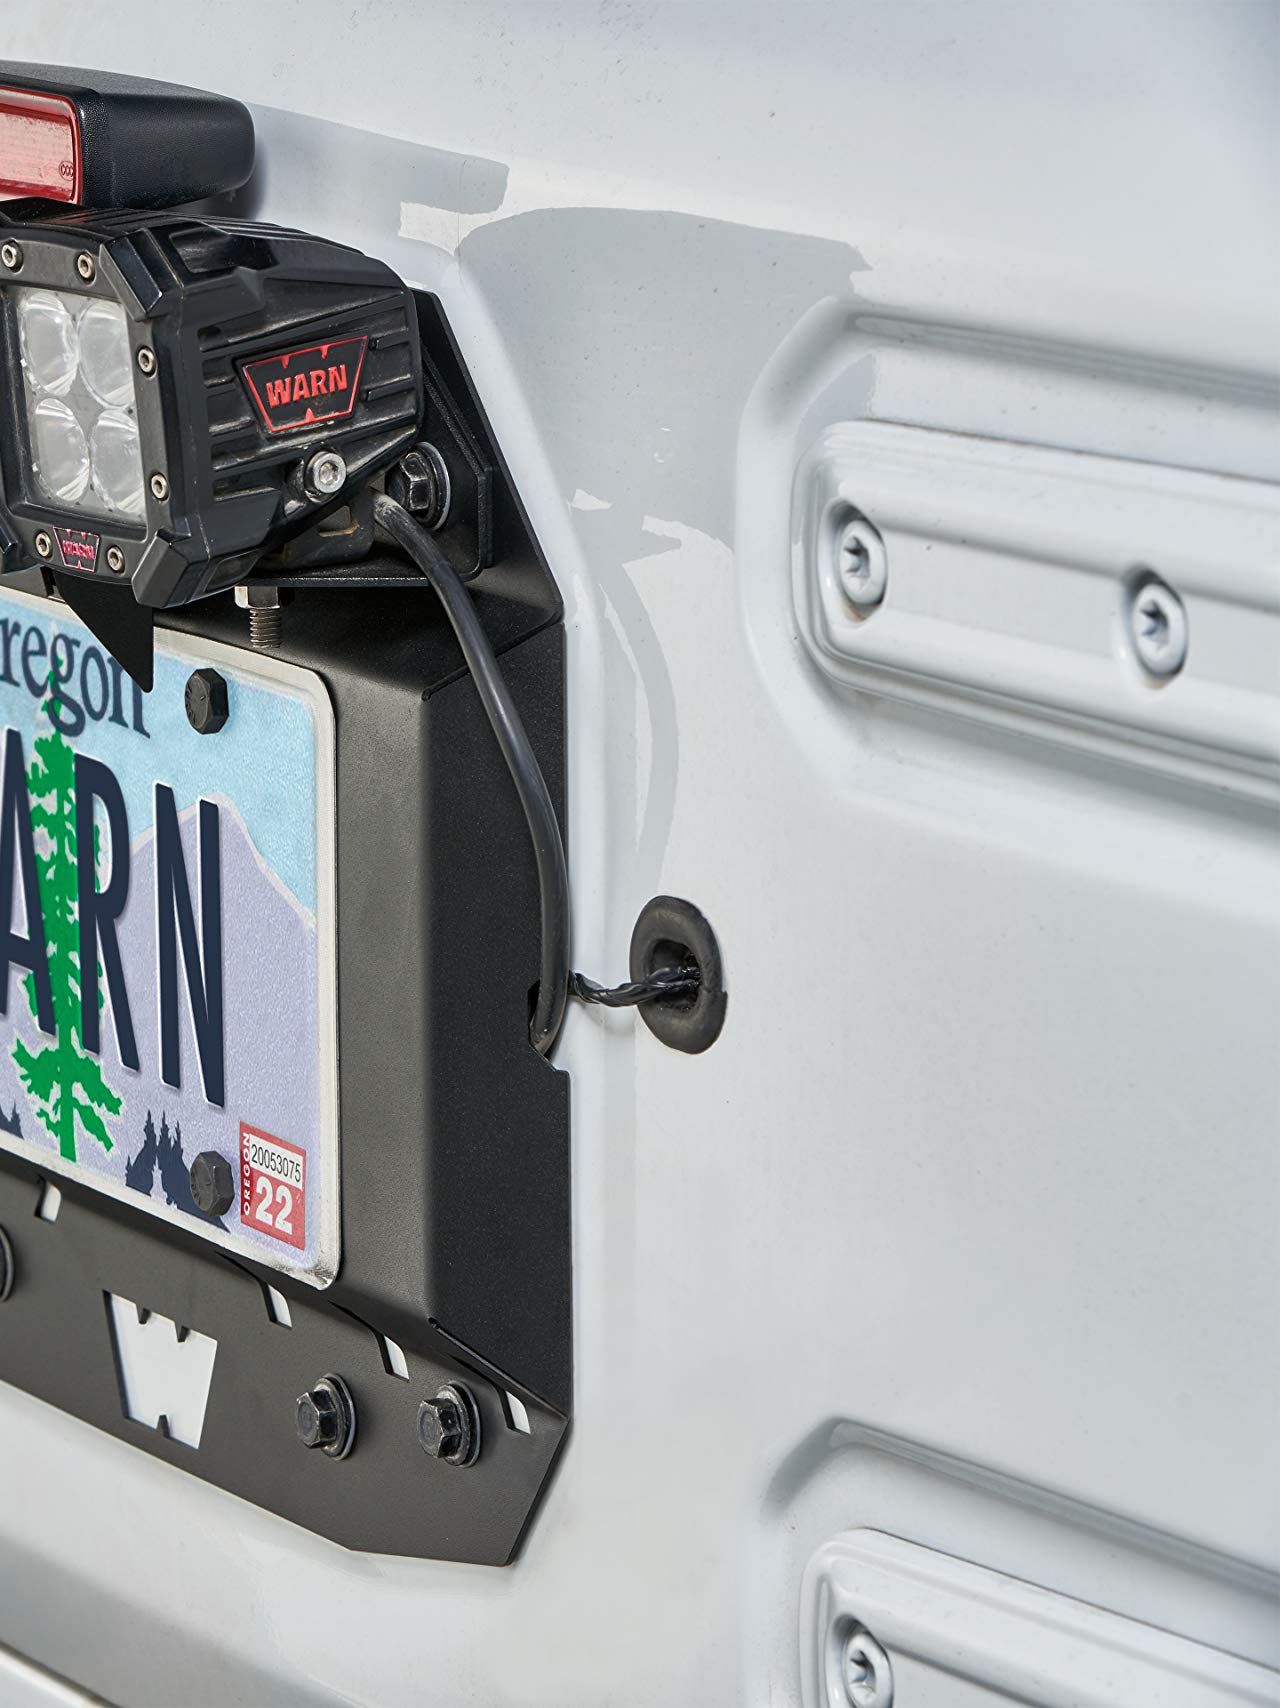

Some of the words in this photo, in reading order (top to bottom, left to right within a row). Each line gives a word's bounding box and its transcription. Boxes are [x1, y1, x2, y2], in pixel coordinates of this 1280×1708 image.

[265, 363, 348, 409] WARN
[242, 1132, 252, 1216] OREGON
[251, 1144, 302, 1183] 20053075
[255, 1176, 293, 1235] 22
